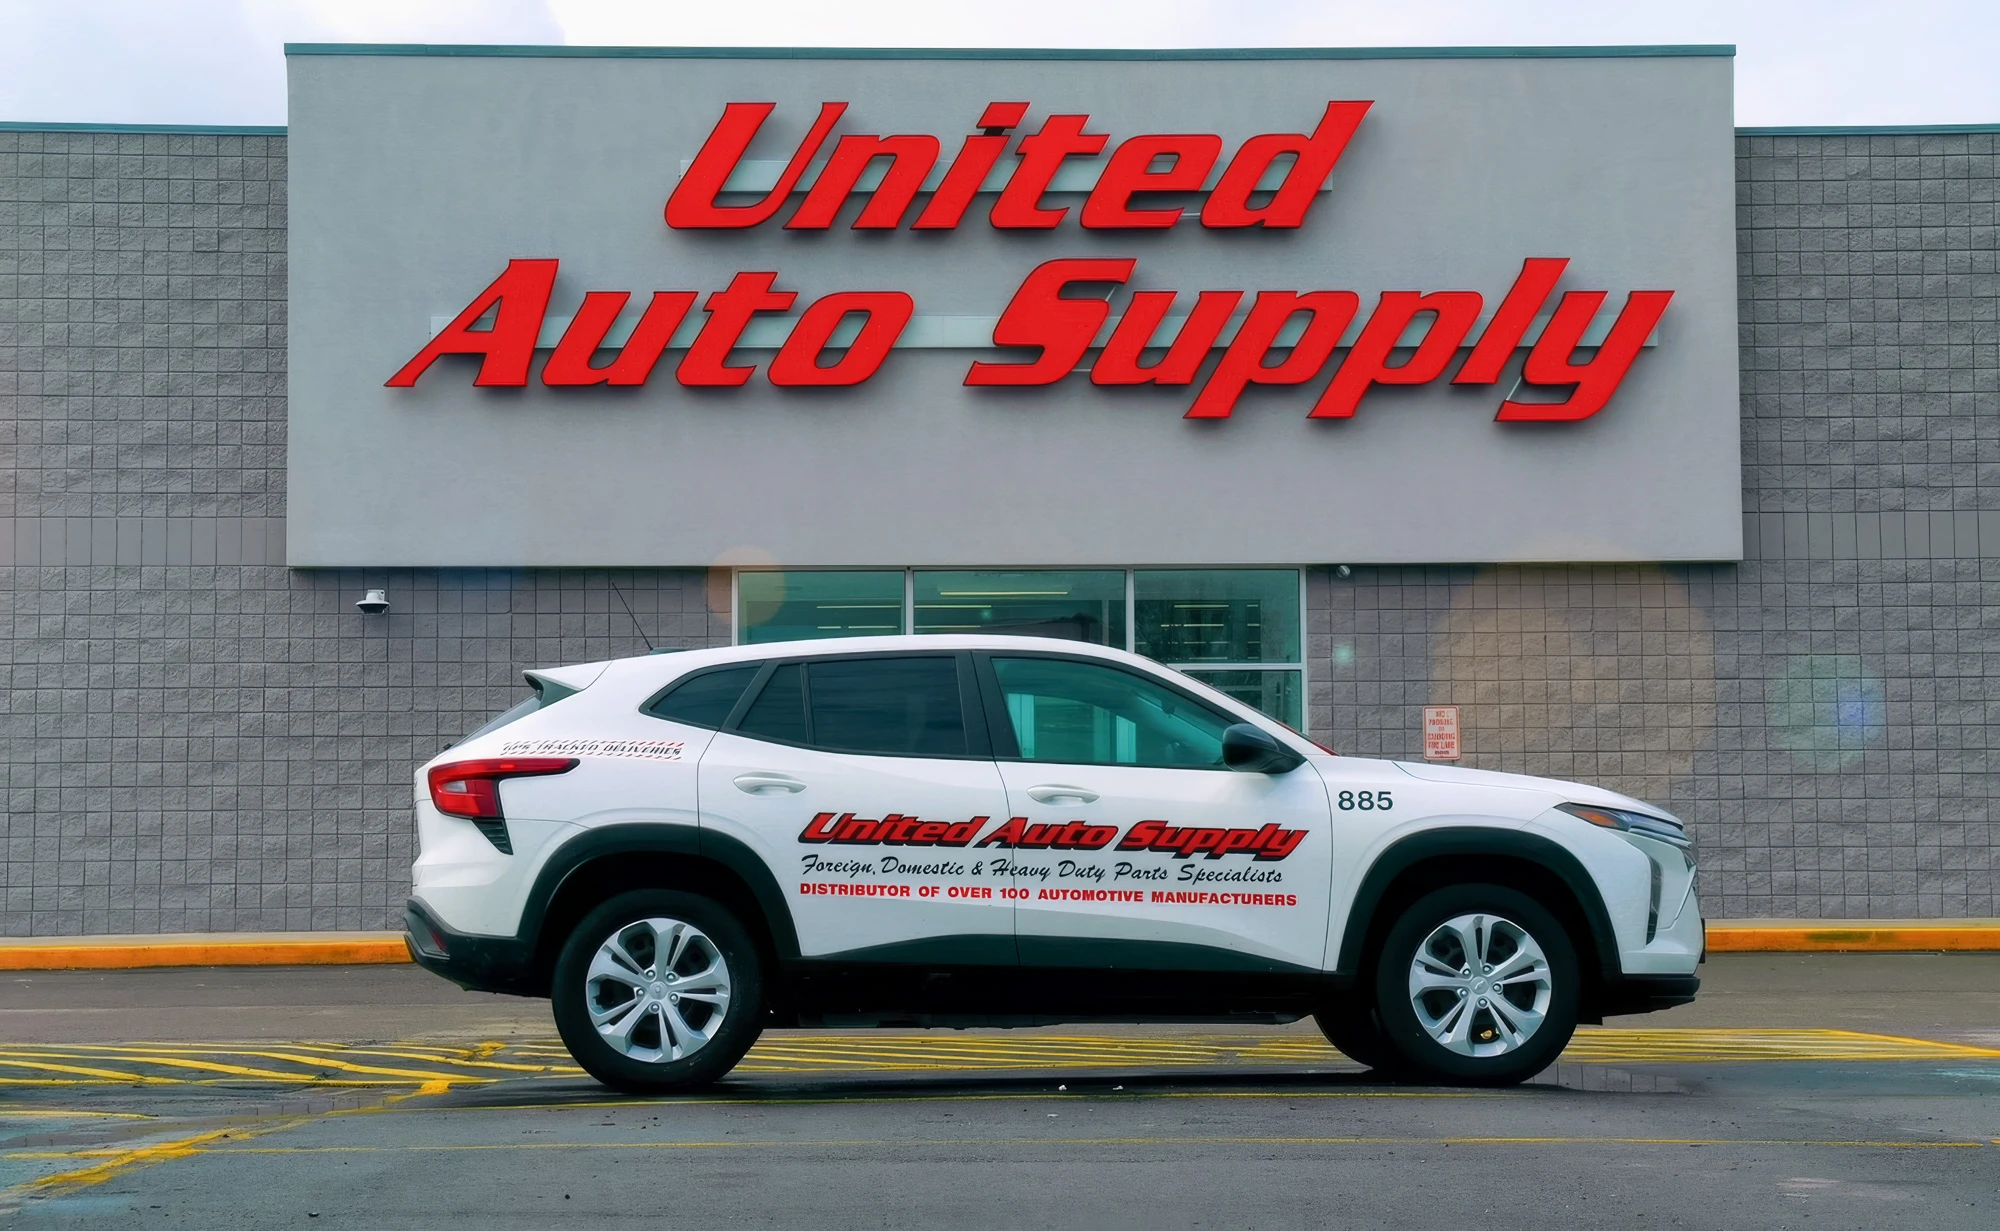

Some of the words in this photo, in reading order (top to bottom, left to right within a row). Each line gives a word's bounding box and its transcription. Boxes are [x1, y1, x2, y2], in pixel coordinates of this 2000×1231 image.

[664, 100, 1375, 230] United
[384, 258, 914, 387] Auto
[963, 257, 1675, 422] Supply
[1338, 790, 1393, 811] 885
[798, 812, 991, 849] United
[972, 816, 1119, 851] Auto
[1113, 820, 1310, 862] Supply
[880, 856, 965, 876] Domestic
[971, 861, 984, 876] &
[990, 858, 1053, 881] Heavy
[1057, 860, 1106, 883] Duty
[1114, 862, 1169, 880] Parts
[1177, 864, 1283, 885] Specialists
[800, 883, 911, 897] DISTRIBUTOR
[918, 886, 940, 897] OF
[947, 886, 992, 899] OVER
[999, 888, 1030, 900] 100
[1038, 889, 1144, 902] AUTOMOTIVE
[1150, 891, 1297, 906] MANUFACTURERS
